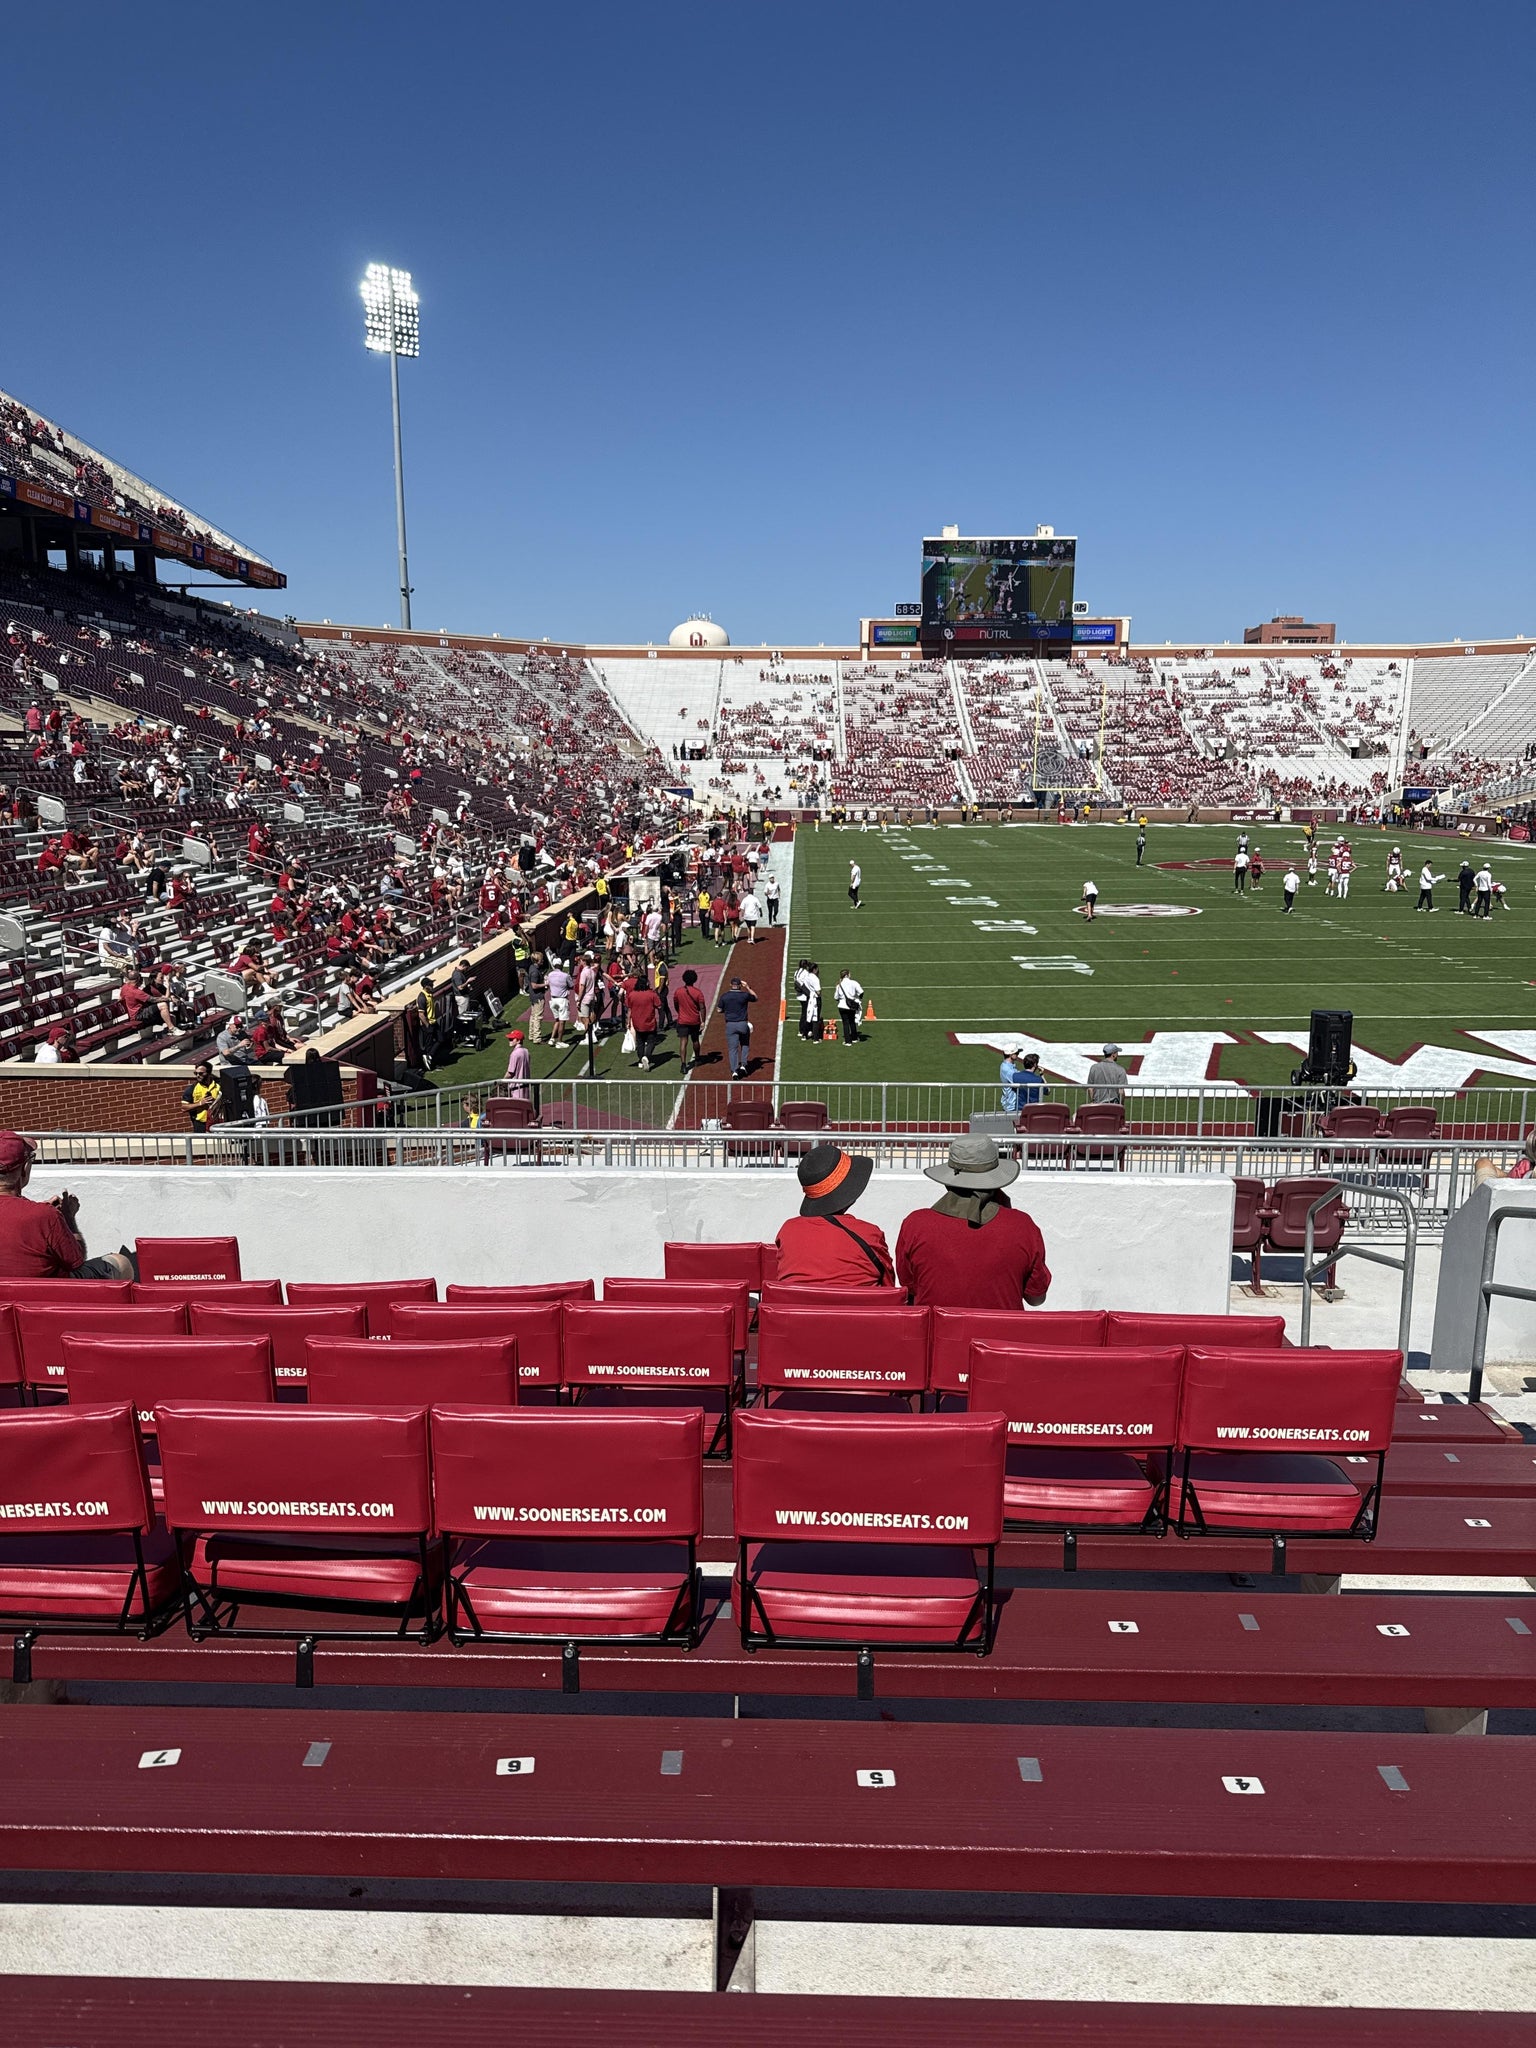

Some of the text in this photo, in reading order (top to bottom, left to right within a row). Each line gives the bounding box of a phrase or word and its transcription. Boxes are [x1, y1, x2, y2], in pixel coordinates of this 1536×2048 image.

[40, 493, 52, 504] CRISP
[488, 890, 496, 901] 6
[588, 1365, 710, 1377] WWW.SOONERSEATS.COM
[784, 1368, 906, 1381] WWW.SOONERSEATS.COM
[1007, 1421, 1153, 1435] WW.SOONERSEATS.COM
[1216, 1426, 1370, 1442] WWW.SOONERSEATS.COM
[0, 1501, 109, 1519] NERSEATS.COM
[201, 1501, 394, 1517] WWW.SOONERSEATS.COM
[473, 1506, 667, 1523] WWW.SOONERSEATS.COM
[775, 1510, 969, 1530] WWW.SOONERSEATS.COM
[152, 1751, 168, 1765] 7
[869, 1771, 884, 1785] 5
[1234, 1778, 1251, 1791] 4
